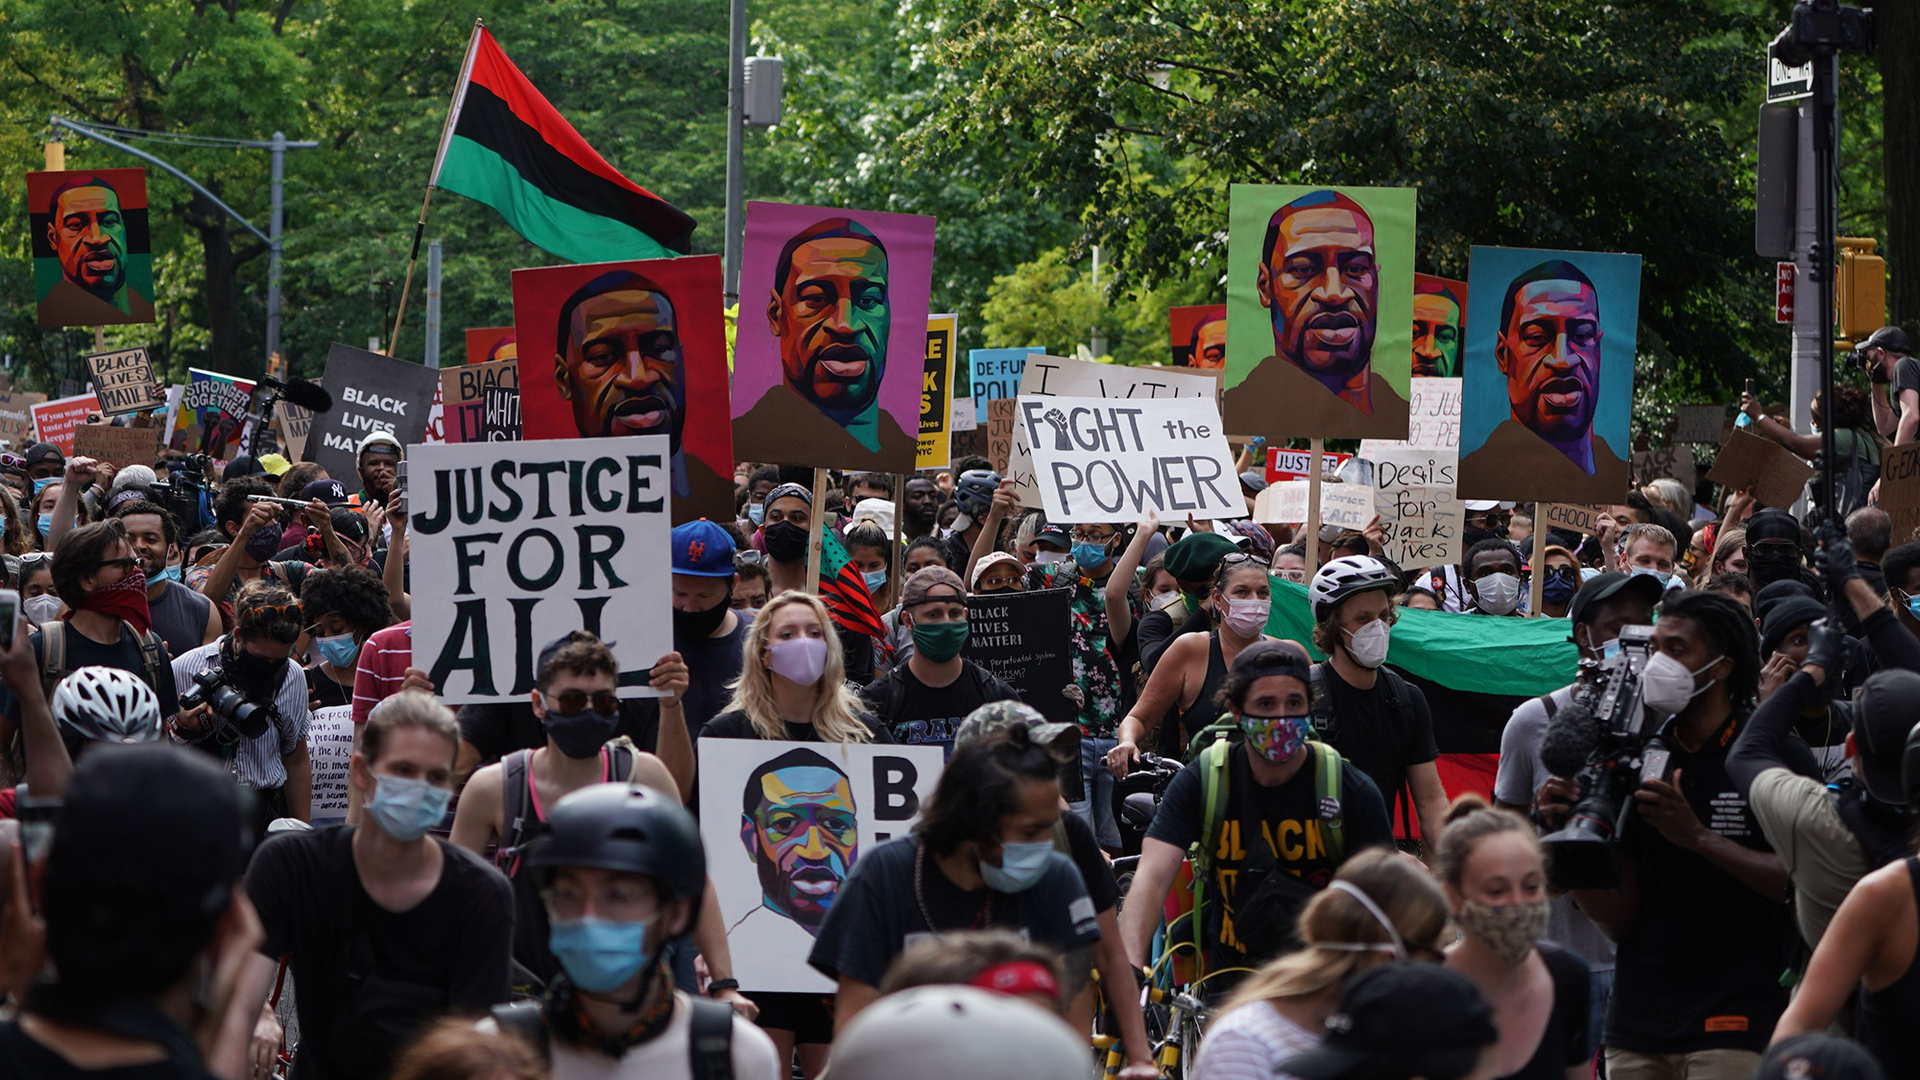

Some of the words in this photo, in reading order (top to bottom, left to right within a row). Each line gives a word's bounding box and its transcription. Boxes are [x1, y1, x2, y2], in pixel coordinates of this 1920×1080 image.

[1781, 270, 1791, 281] NO
[95, 352, 147, 374] BLACK
[96, 367, 149, 387] LIVES
[185, 380, 250, 407] STRONGER
[342, 387, 409, 417] BLACK
[49, 411, 63, 423] you
[64, 408, 83, 417] want
[182, 393, 249, 422] TOGETHER!
[77, 427, 109, 438] DON'T
[115, 430, 140, 439] TELL
[341, 412, 396, 436] LIVES
[919, 420, 939, 429] Lives
[1163, 420, 1211, 439] the
[75, 448, 106, 458] BLACK
[76, 440, 96, 448] ALL
[101, 441, 133, 451] LIVES
[1379, 459, 1454, 489] Desis
[331, 483, 344, 497] NY
[412, 455, 665, 535] JUSTICE
[1051, 456, 1231, 515] POWER
[1393, 490, 1435, 521] for
[1381, 522, 1449, 546] Black
[452, 524, 629, 595] FOR
[970, 606, 1009, 619] BLACK
[971, 621, 1010, 633] LIVES
[428, 596, 658, 696] ALL
[990, 653, 1032, 672] perpetuated
[318, 747, 332, 756] the
[873, 756, 919, 821] B
